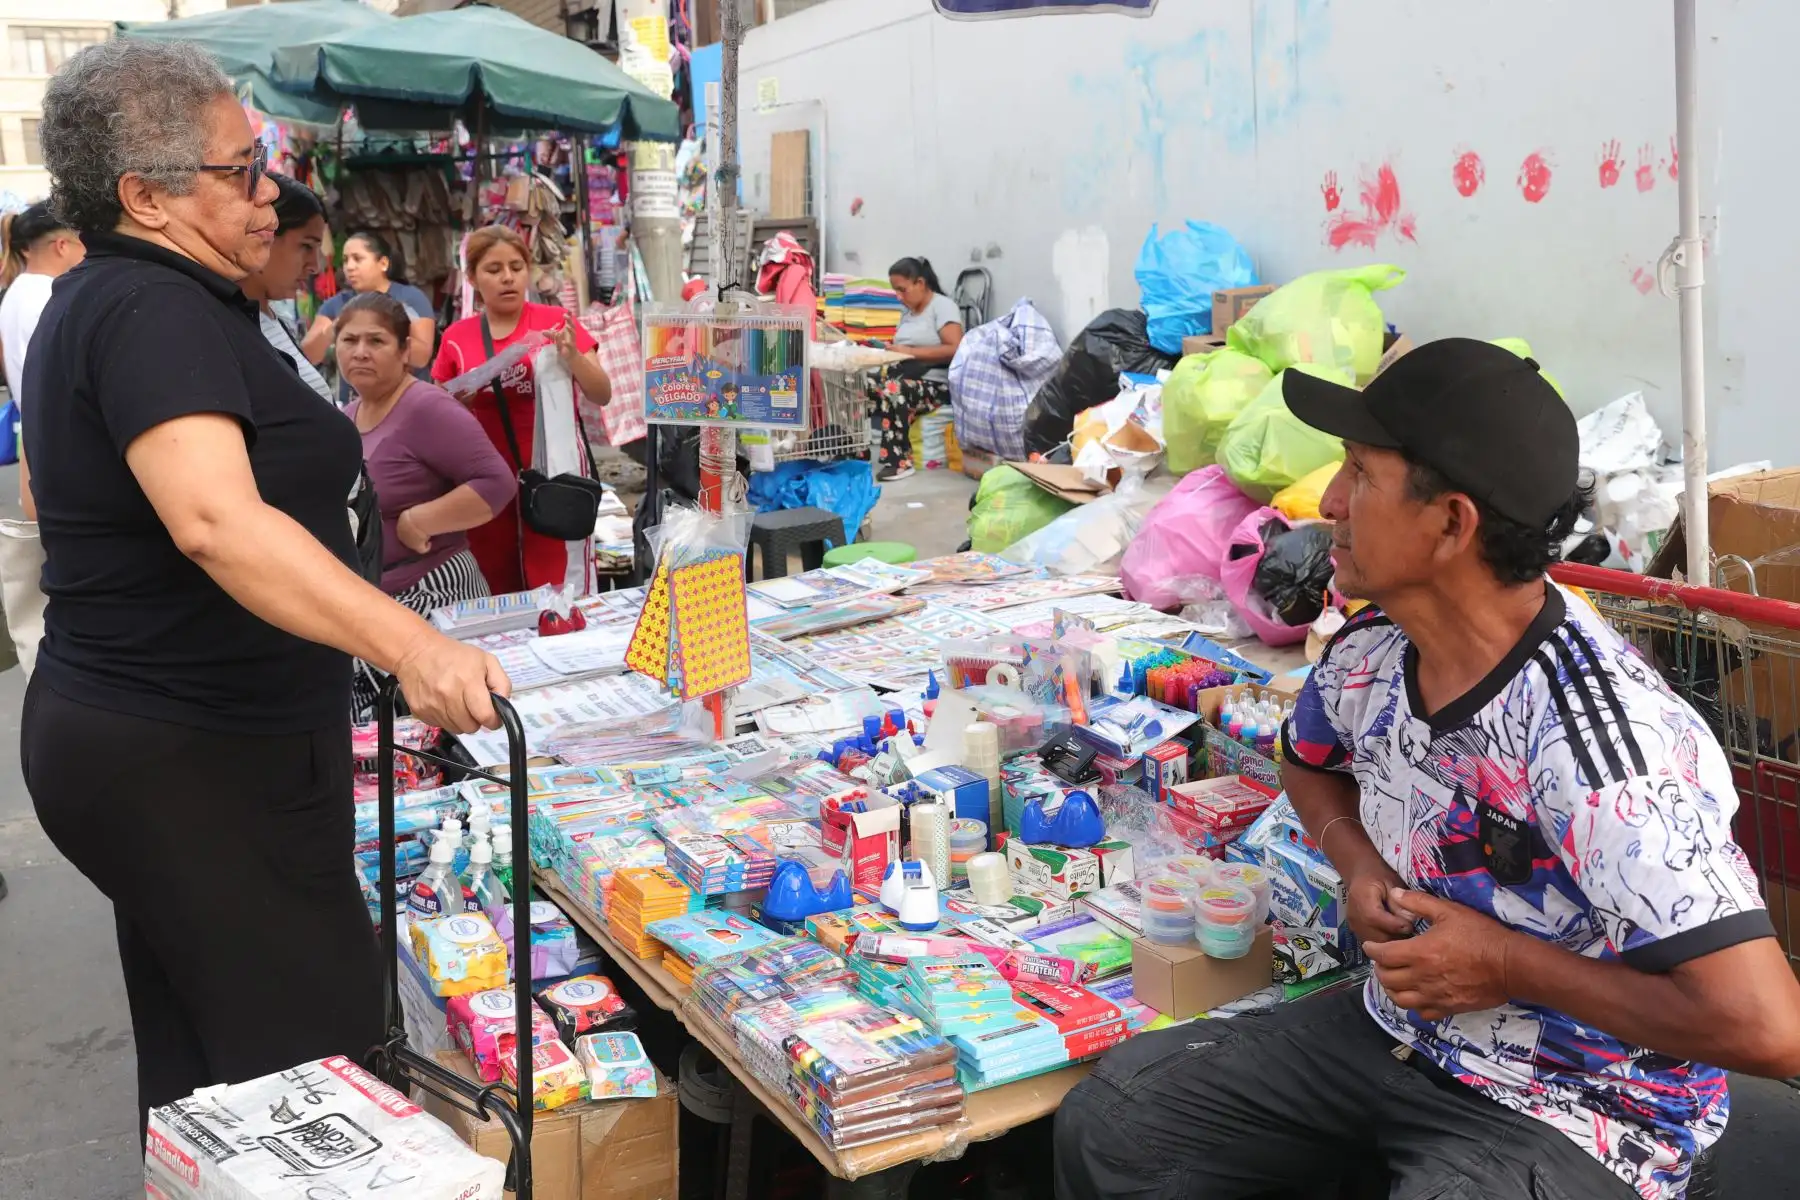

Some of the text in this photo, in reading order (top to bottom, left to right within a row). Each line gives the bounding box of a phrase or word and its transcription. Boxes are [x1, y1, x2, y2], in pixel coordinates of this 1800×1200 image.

[516, 381, 533, 394] 28
[661, 381, 696, 393] Colores
[655, 391, 702, 406] DELGADO
[1237, 749, 1264, 769] Goma
[1486, 809, 1518, 831] JAPAN
[1314, 877, 1336, 895] UNIDADES
[427, 901, 437, 911] GEL
[468, 902, 478, 911] GEL
[1295, 939, 1309, 950] 25
[1022, 963, 1062, 978] PIRATERÍA
[1273, 960, 1284, 969] 25
[198, 1134, 228, 1160] DELUXE
[153, 1138, 197, 1182] Standford
